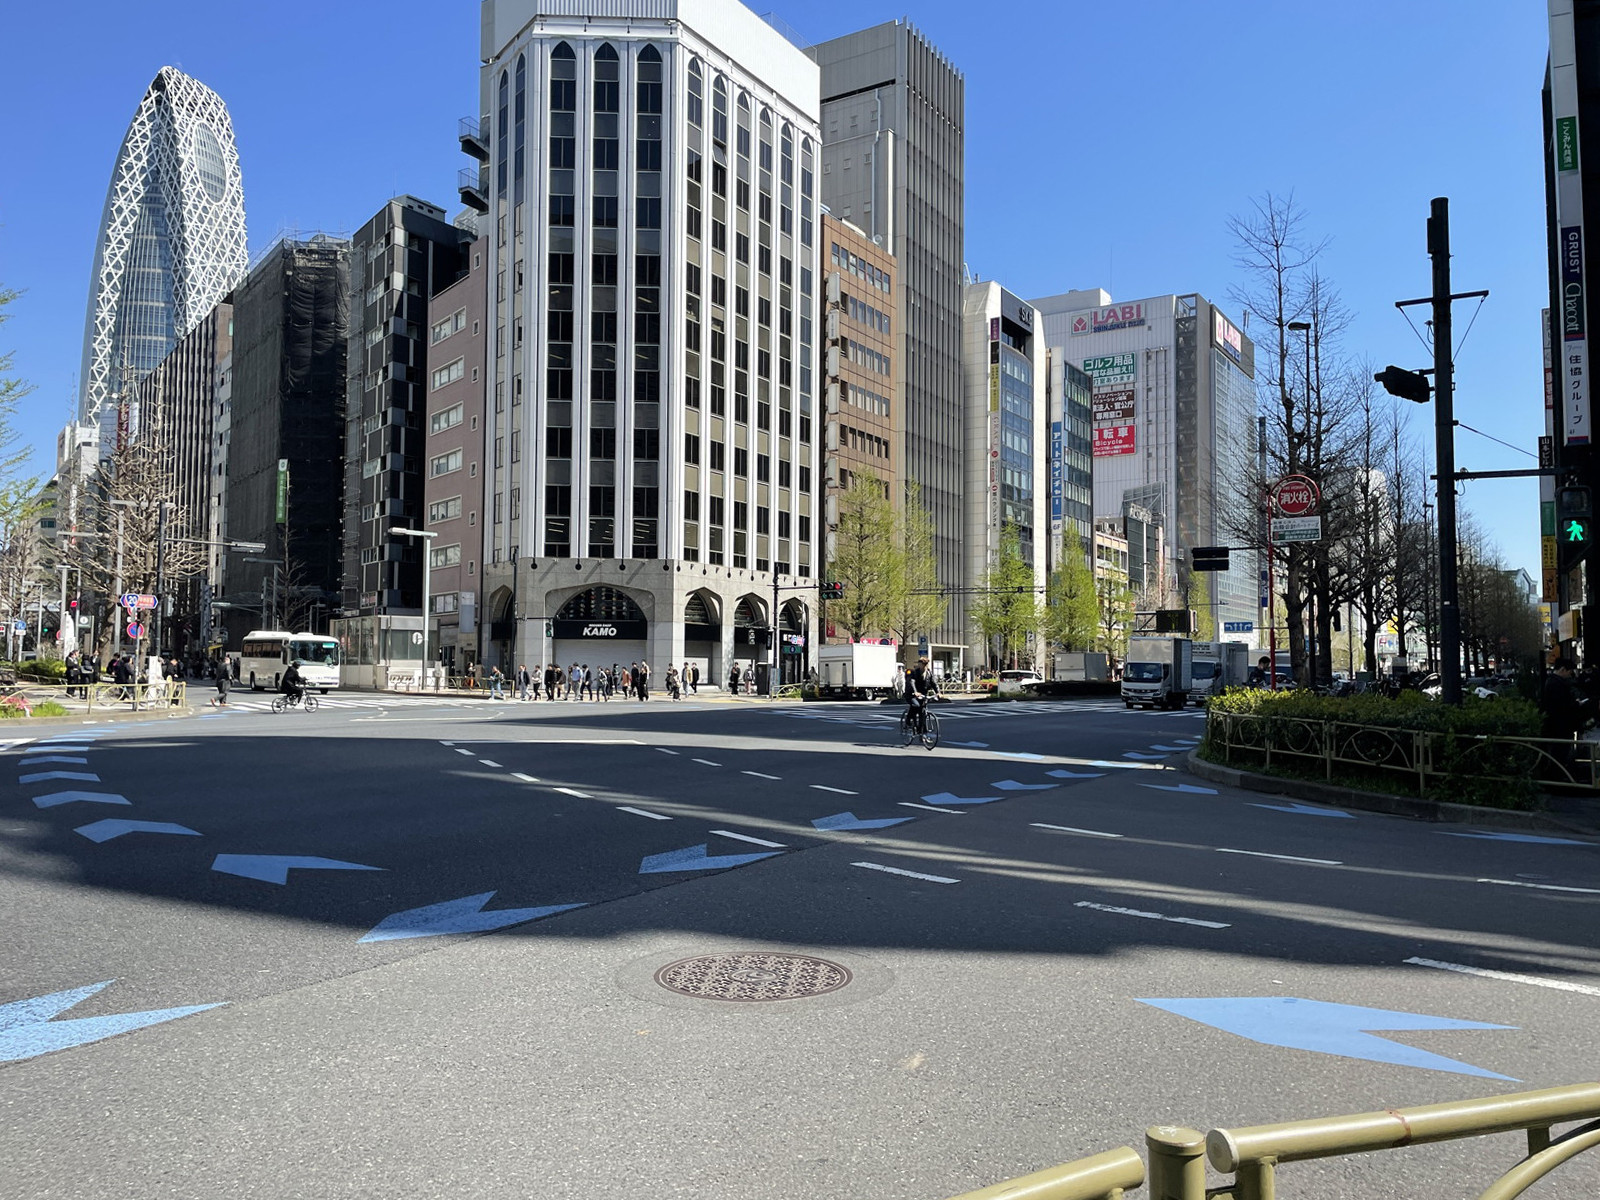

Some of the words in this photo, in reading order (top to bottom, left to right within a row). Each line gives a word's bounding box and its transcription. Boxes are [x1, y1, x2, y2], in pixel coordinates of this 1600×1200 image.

[1568, 232, 1580, 274] GRUST
[1093, 304, 1141, 326] LABI
[1565, 282, 1582, 332] Chacott
[1085, 354, 1133, 370] ゴルフ用品
[1569, 355, 1583, 425] 住協グループ
[1095, 439, 1123, 447] Bicycle
[1053, 432, 1061, 505] アートネイチャー
[1281, 491, 1308, 505] 消火栓
[1053, 523, 1061, 531] 6F
[583, 627, 617, 636] KAMO
